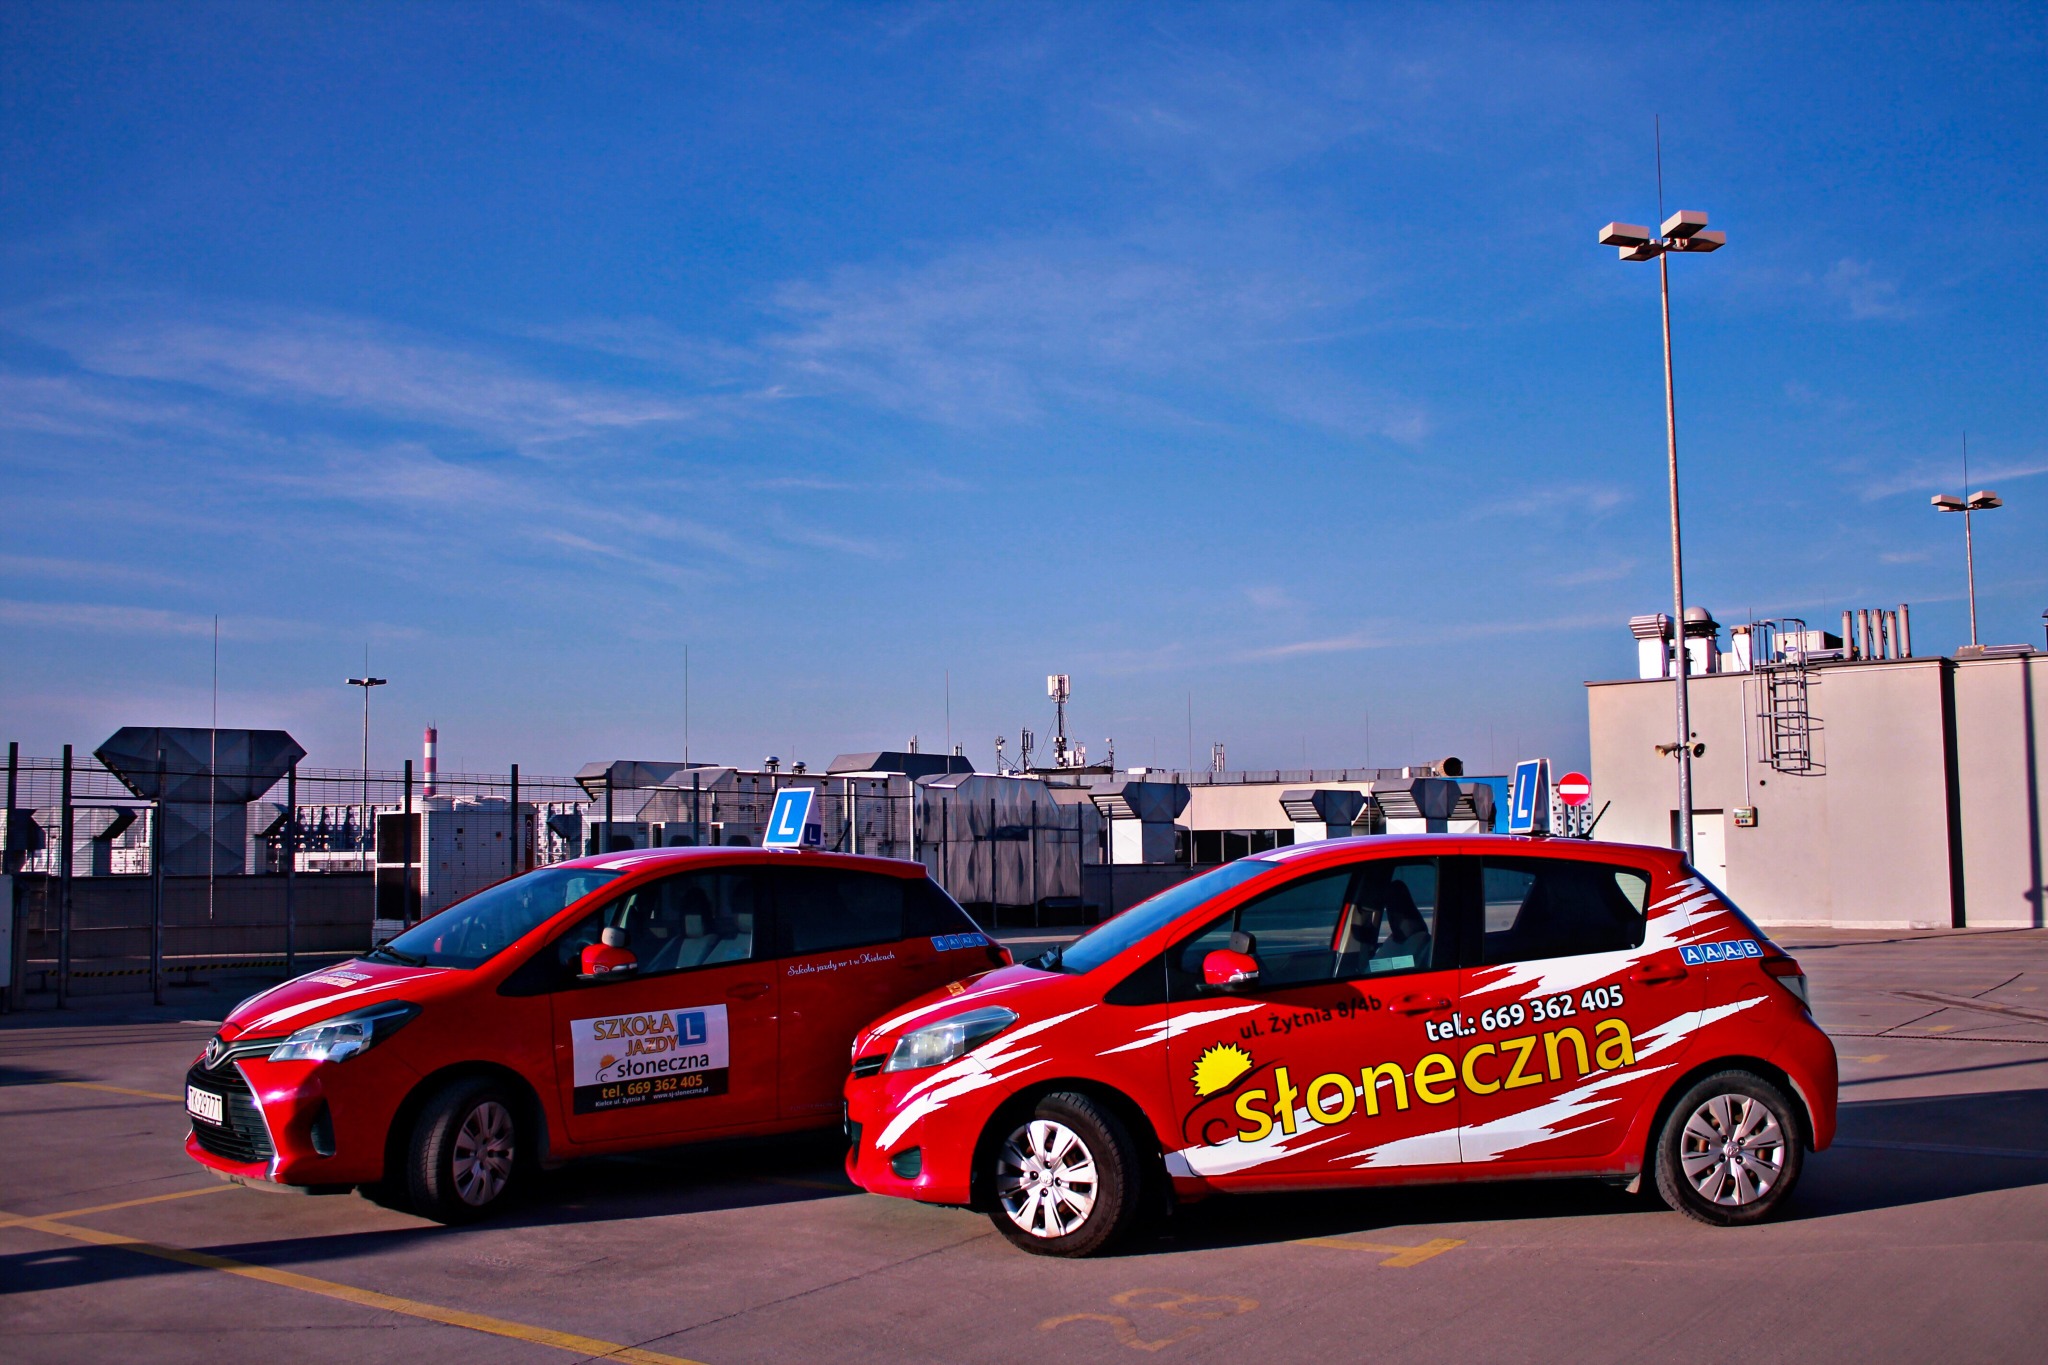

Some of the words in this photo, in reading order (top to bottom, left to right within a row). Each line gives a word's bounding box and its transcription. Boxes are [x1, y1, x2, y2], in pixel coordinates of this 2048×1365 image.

[1517, 774, 1528, 819] L
[778, 799, 795, 835] L
[809, 827, 817, 842] L
[816, 960, 837, 973] jazdy
[859, 950, 895, 964] Kielcach
[1687, 948, 1700, 961] A
[1743, 942, 1758, 954] B
[1239, 1019, 1264, 1039] ul.
[1268, 1006, 1333, 1035] Żytnia
[1336, 994, 1382, 1019] 8/4b
[1424, 1011, 1477, 1042] tel.:
[1479, 1002, 1526, 1033] 669
[1528, 992, 1577, 1023] 362
[1580, 984, 1625, 1014] 405
[593, 1013, 675, 1041] SZKOŁA
[685, 1017, 700, 1041] L
[625, 1034, 679, 1057] JAZDY
[617, 1053, 709, 1078] słoneczna
[602, 1084, 624, 1099] tel.
[627, 1080, 651, 1095] 669
[654, 1078, 678, 1093] 362
[680, 1074, 703, 1088] 405
[1233, 1016, 1637, 1144] słoneczna
